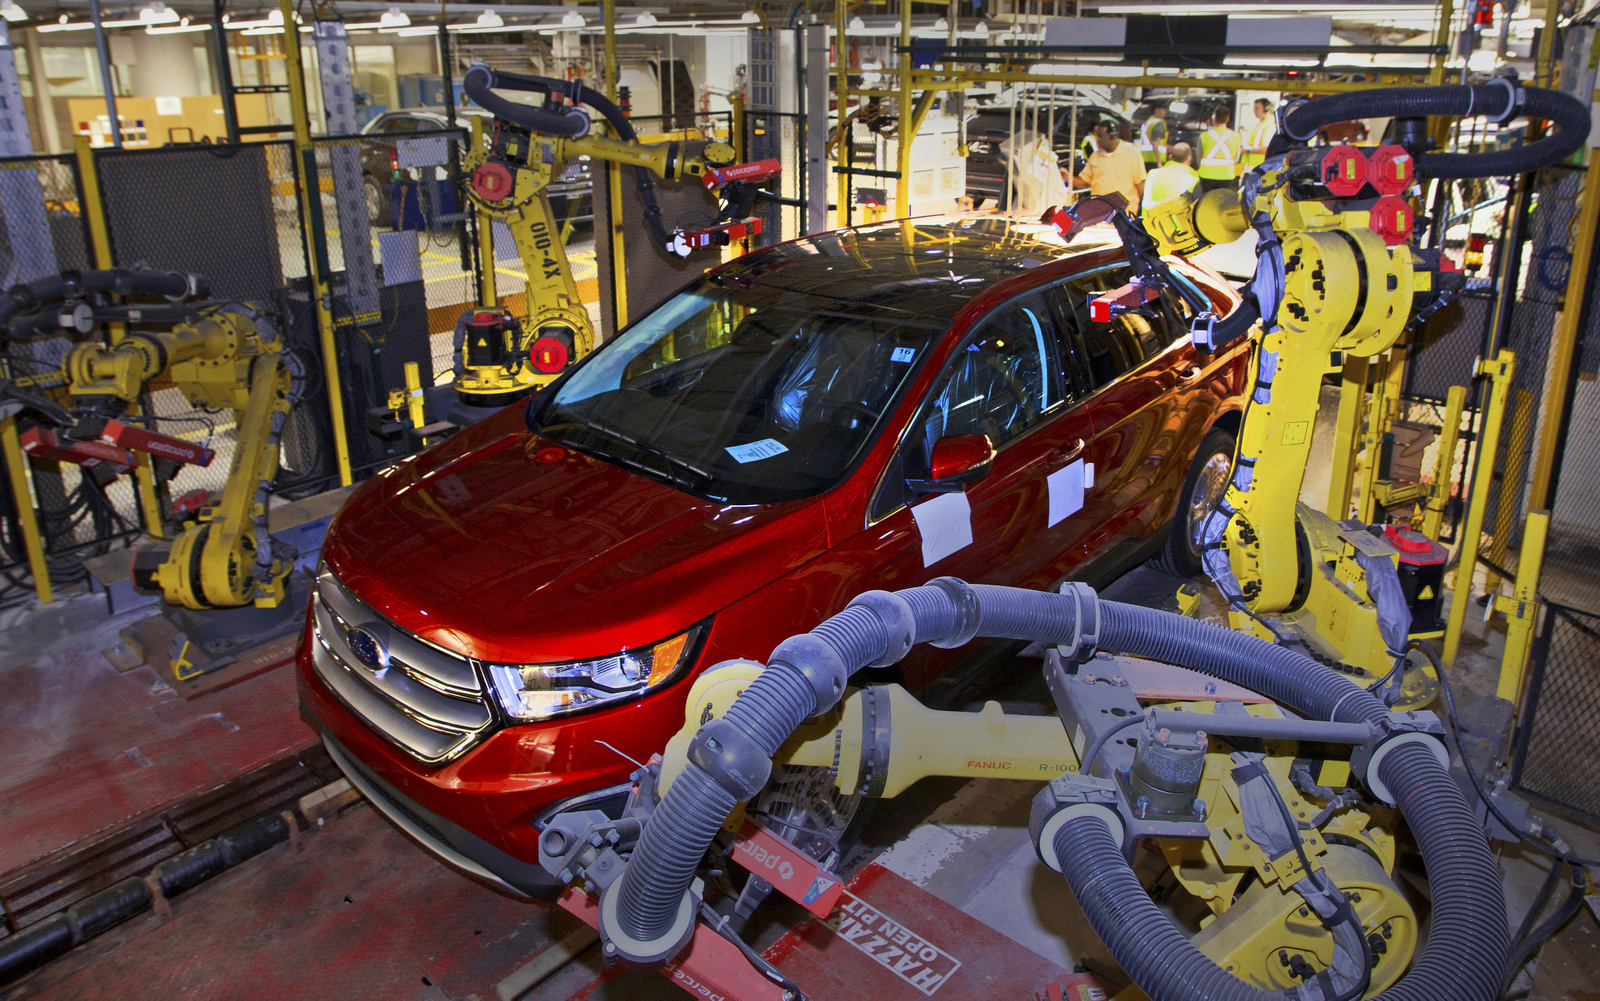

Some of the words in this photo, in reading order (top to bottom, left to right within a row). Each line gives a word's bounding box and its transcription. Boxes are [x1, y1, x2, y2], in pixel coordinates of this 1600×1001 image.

[530, 221, 561, 280] 010-4X
[967, 760, 1012, 770] FANUC
[841, 900, 880, 926] PIT
[827, 908, 943, 990] HAZZAR
[877, 920, 938, 962] OPEN
